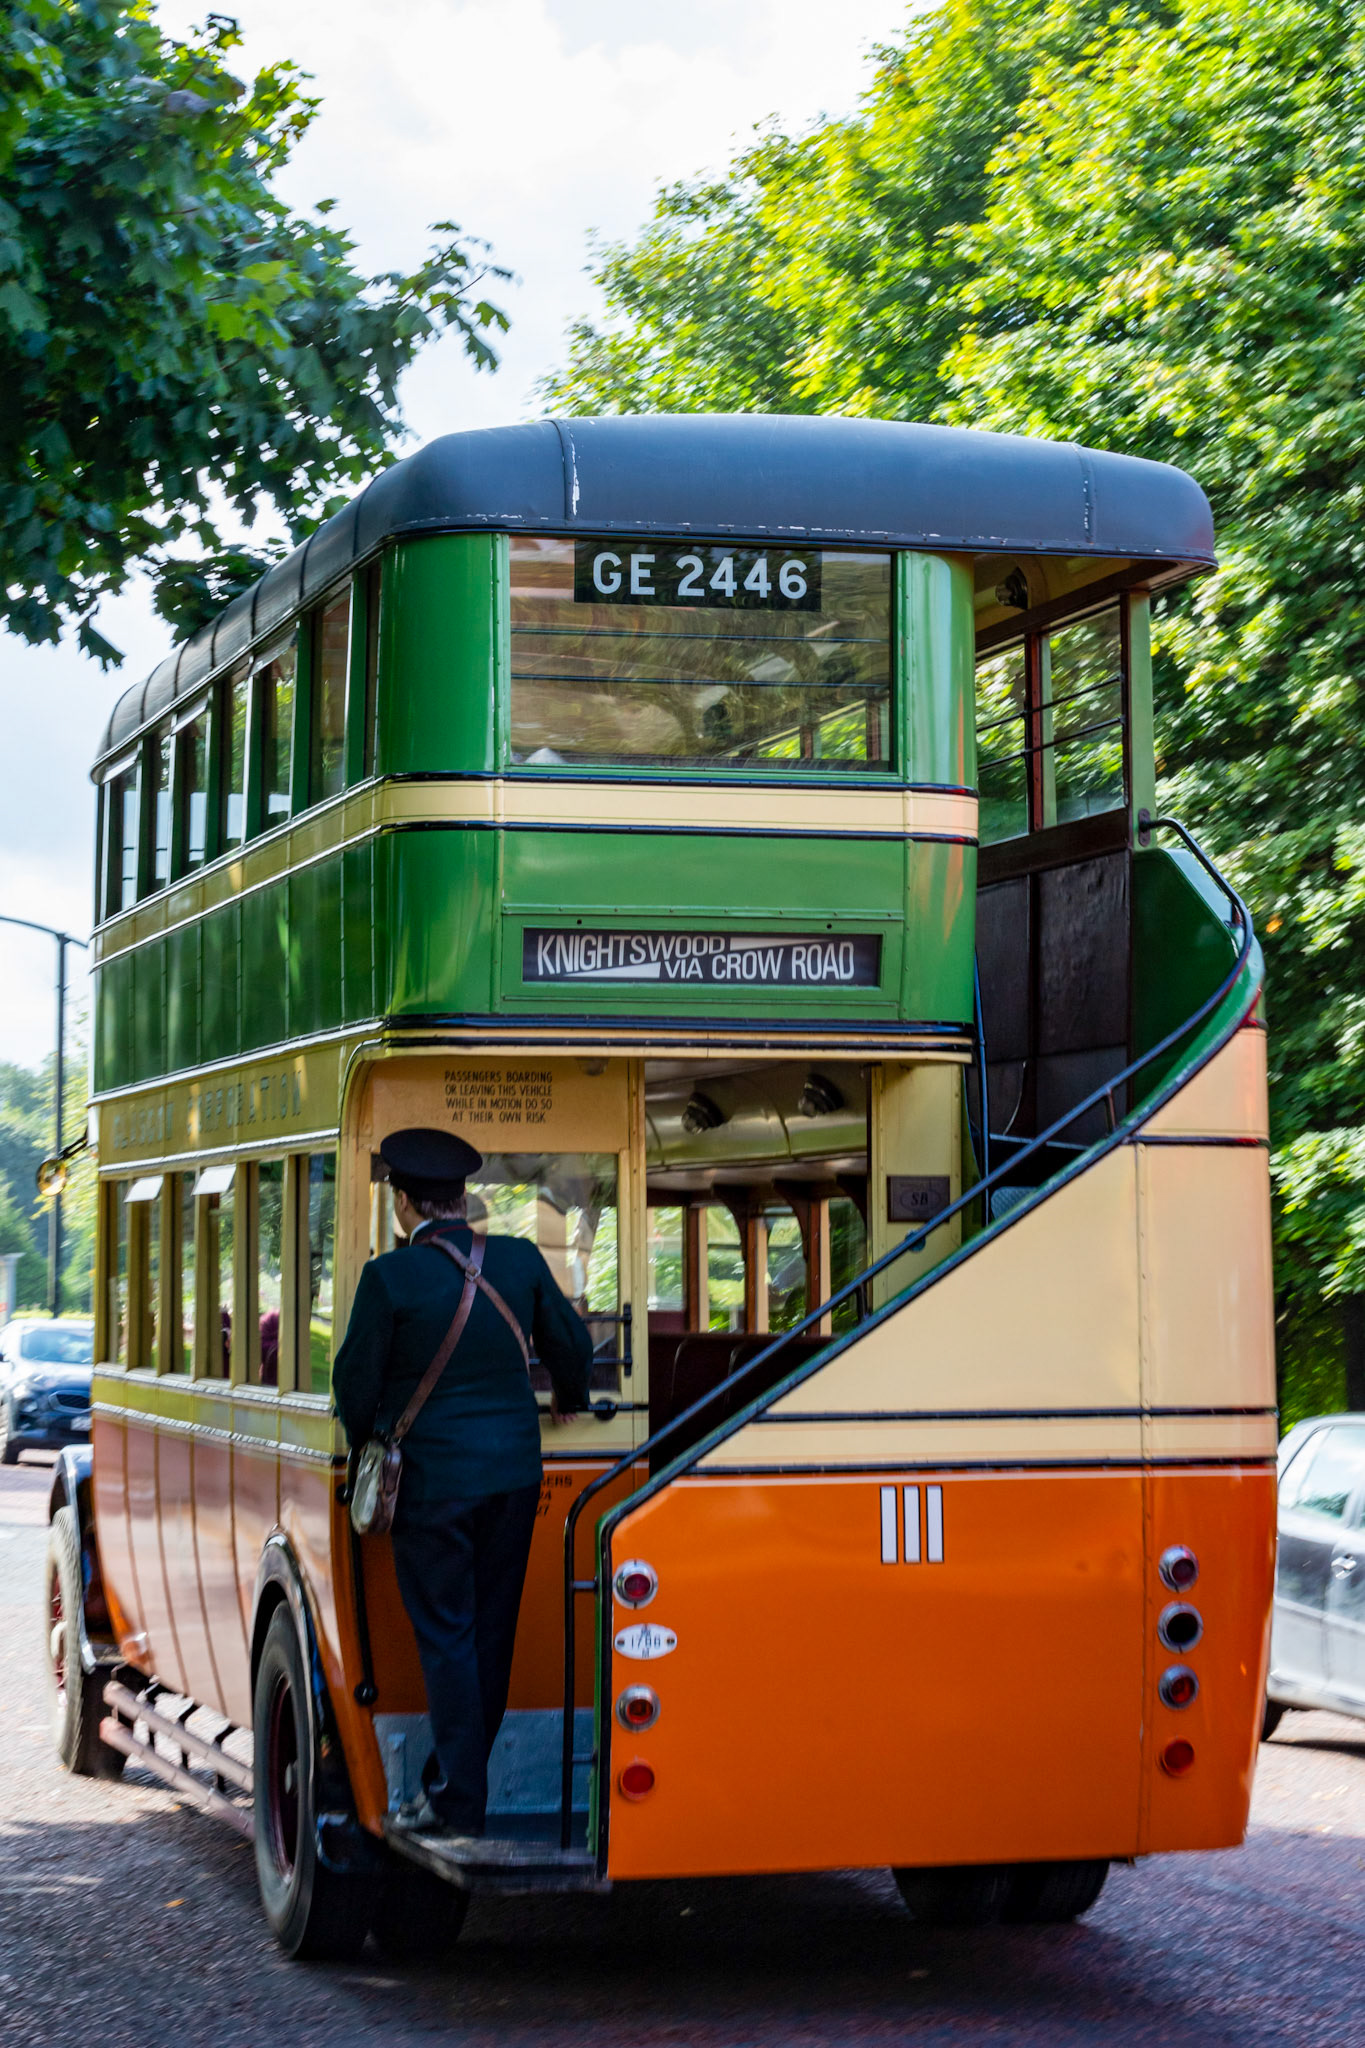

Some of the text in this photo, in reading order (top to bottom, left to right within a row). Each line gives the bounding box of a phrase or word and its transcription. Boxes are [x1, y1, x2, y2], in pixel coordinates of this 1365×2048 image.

[593, 551, 808, 600] GE 2446
[537, 934, 725, 977] KNIGHTSWOOD
[664, 942, 855, 981] VIA CROW ROAD
[444, 1071, 553, 1083] PASSENGERS BOARDING
[445, 1085, 552, 1096] OR LEAVING THIS VEHICLE
[446, 1098, 553, 1110] WHILE IN MOTION DO SO
[452, 1111, 546, 1123] AT THEIR OWN RISK
